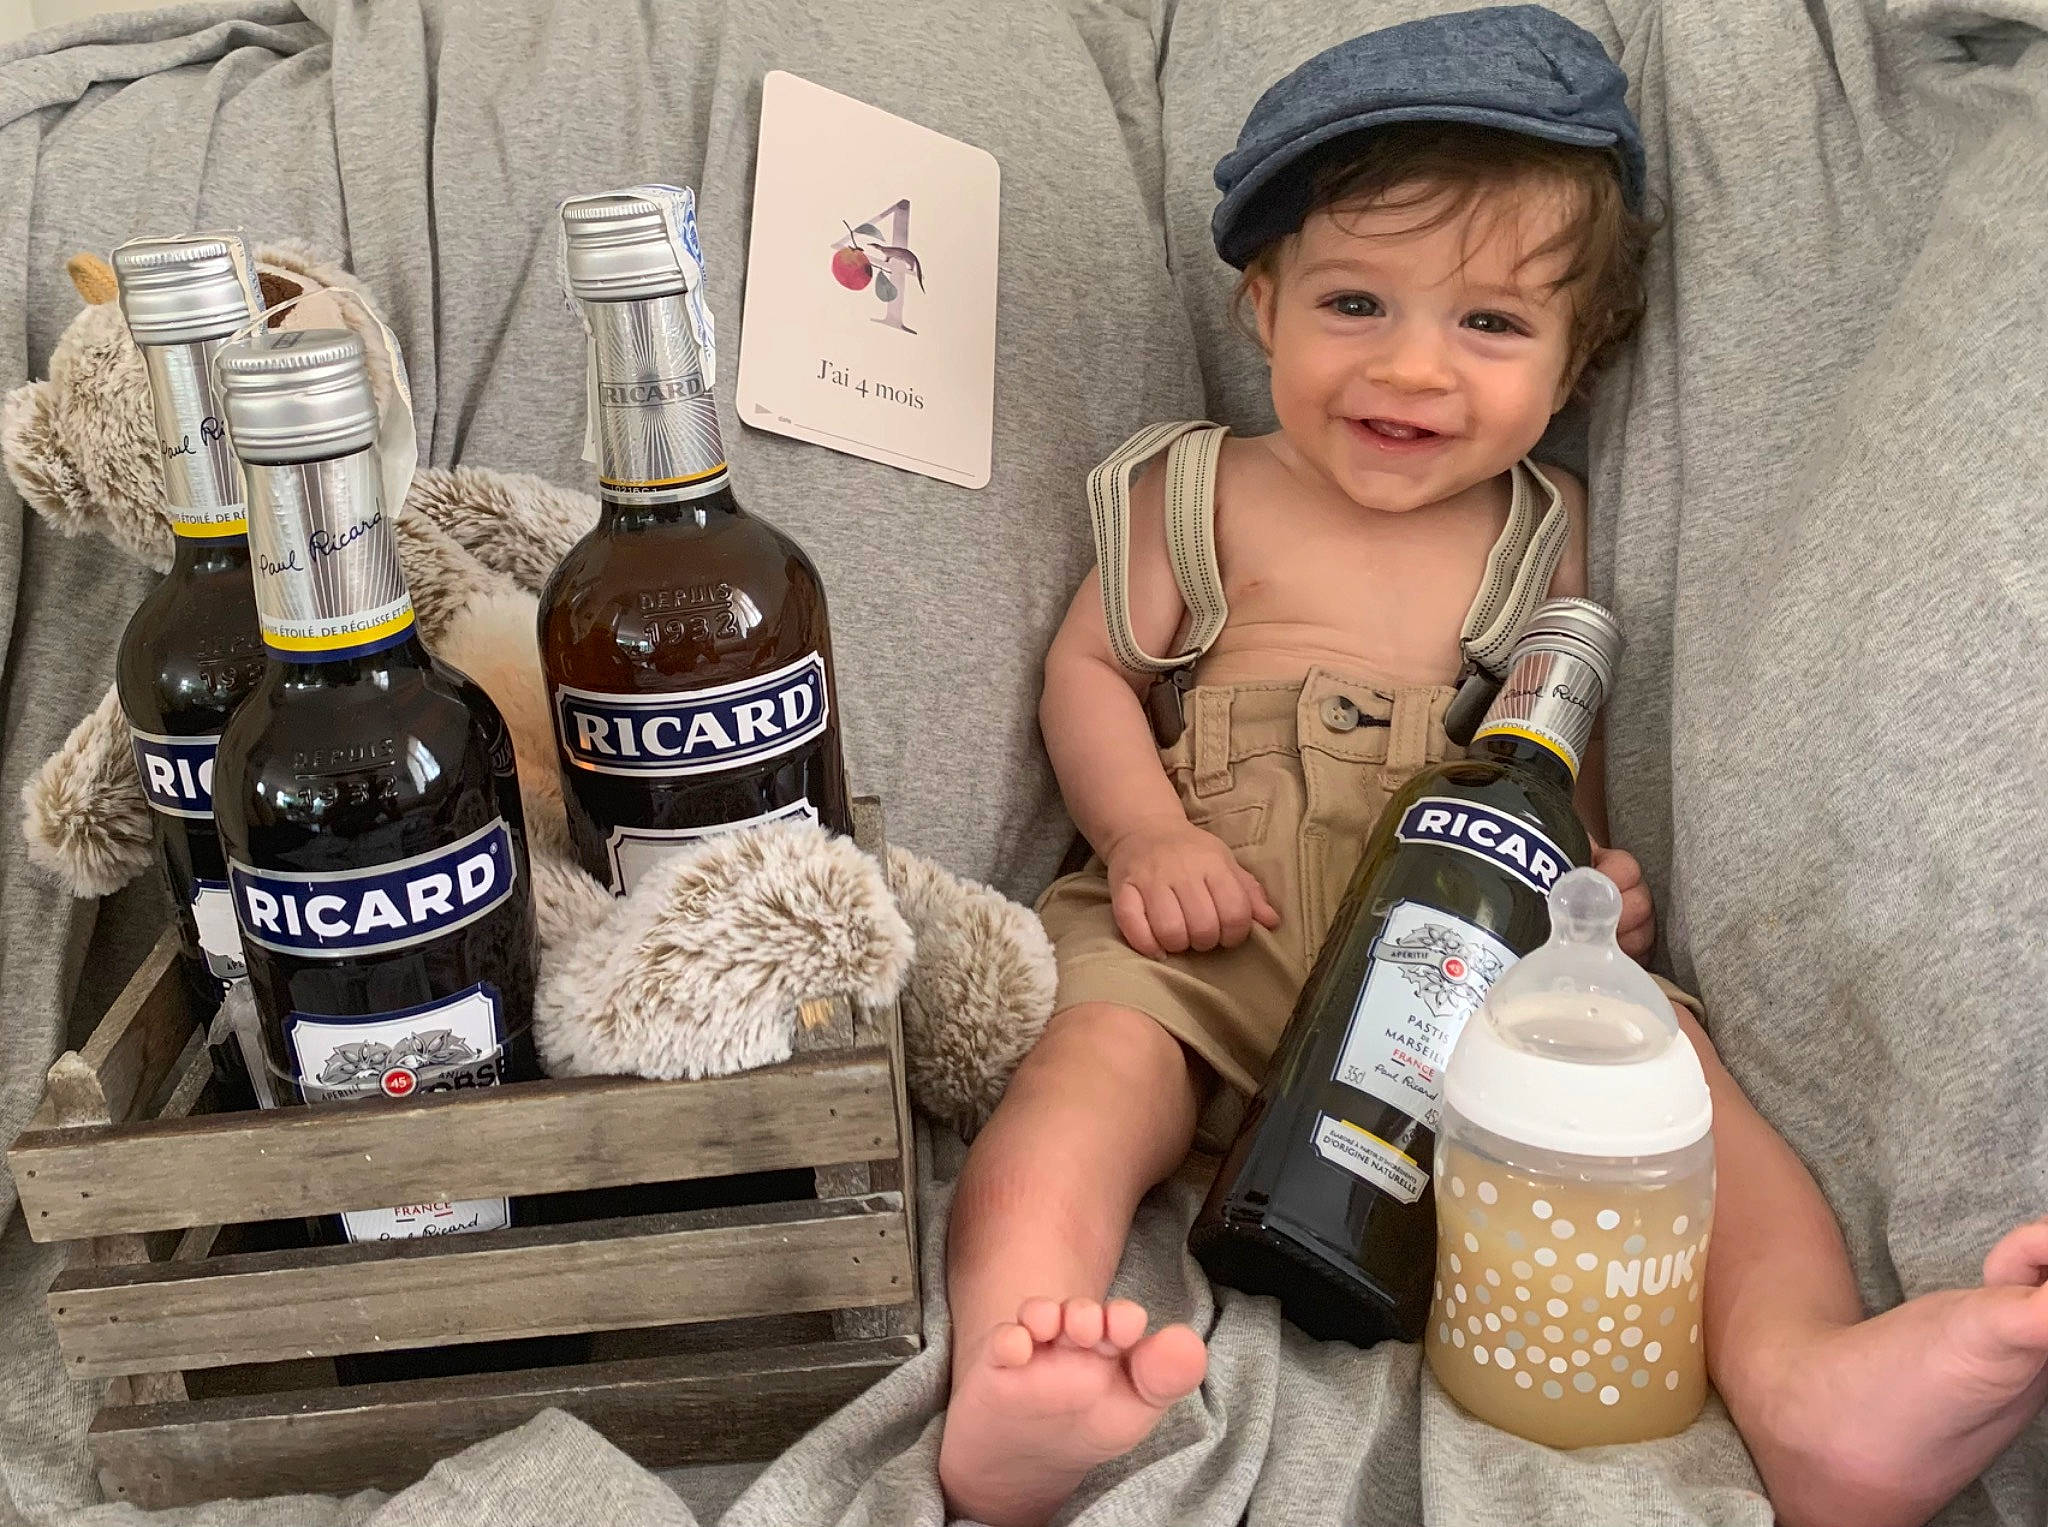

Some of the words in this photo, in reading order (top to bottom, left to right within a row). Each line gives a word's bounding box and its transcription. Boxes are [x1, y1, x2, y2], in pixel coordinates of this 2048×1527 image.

[602, 377, 701, 403] RICARD
[817, 359, 849, 387] J'ai
[855, 379, 869, 398] 4
[875, 382, 924, 410] mois
[216, 512, 231, 523] DE
[260, 550, 304, 579] Paul
[309, 497, 383, 562] Ricard
[639, 583, 733, 610] DEPUIS
[321, 625, 339, 638] DE
[341, 614, 392, 634] RÉGLISSE
[392, 607, 402, 621] ET
[644, 611, 739, 646] 1932
[572, 682, 815, 758] RICARD
[1416, 809, 1570, 890] RICAR
[245, 850, 496, 938] RICARD
[1407, 1014, 1450, 1044] PASTIS
[1392, 1048, 1436, 1077] FRANCE
[390, 1076, 408, 1090] 45
[1374, 1063, 1400, 1083] Paul
[1401, 1075, 1439, 1101] Ricard
[1323, 1135, 1370, 1165] D'ORIGINE
[1370, 1160, 1417, 1195] NATURELLE
[423, 1213, 478, 1238] Ricard
[1605, 1244, 1697, 1299] NUK
